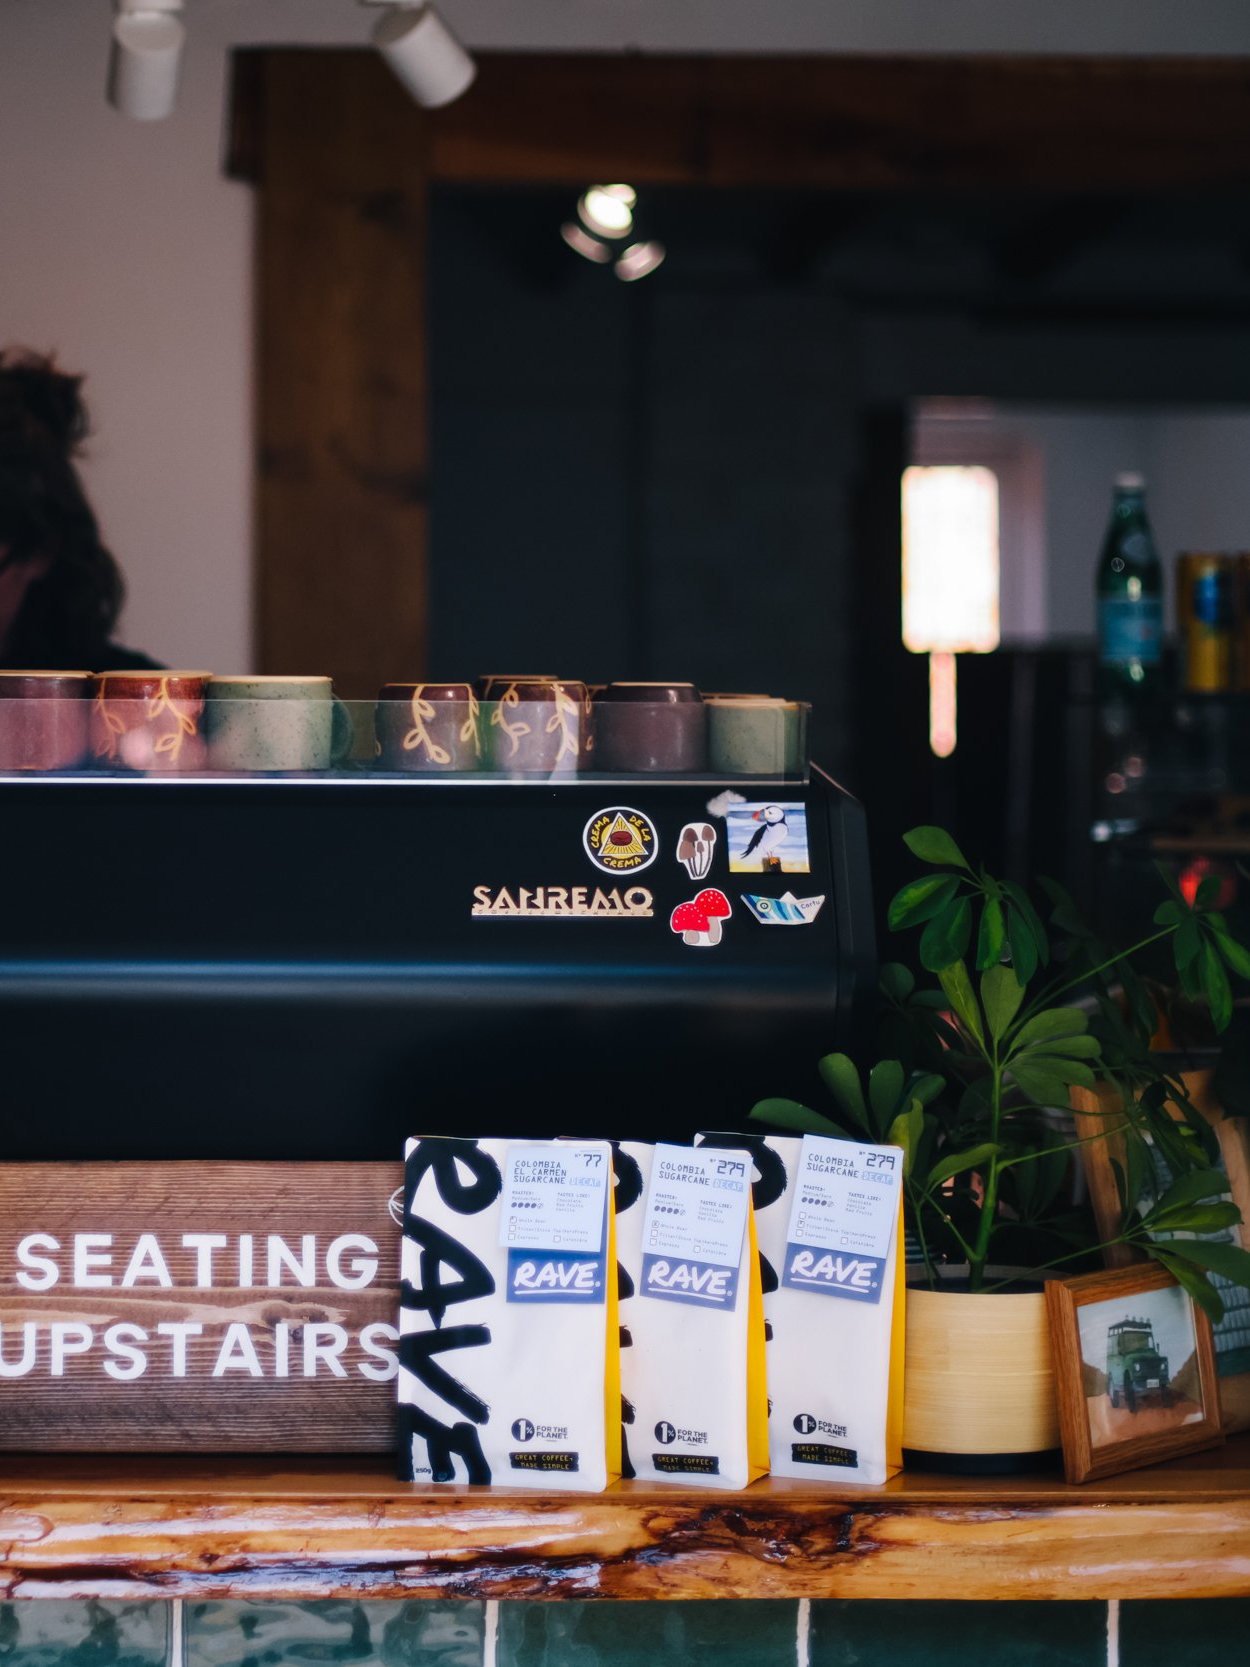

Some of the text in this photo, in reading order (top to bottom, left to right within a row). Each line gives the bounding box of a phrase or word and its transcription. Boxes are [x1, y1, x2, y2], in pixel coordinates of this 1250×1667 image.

[590, 815, 652, 848] CREMA DE LA
[603, 856, 642, 868] CREMA
[472, 885, 653, 910] SANREMO
[515, 1160, 561, 1168] COLOMBIA
[583, 1153, 602, 1168] 77
[660, 1161, 705, 1175] COLOMBIA
[808, 1153, 854, 1168] COLOMBIA
[866, 1152, 895, 1170] 279
[532, 1168, 567, 1177] CARMEN
[717, 1160, 745, 1178] 279
[806, 1163, 894, 1186] SUGARCANE DECAF
[513, 1176, 566, 1184] SUGARCANE
[659, 1171, 710, 1186] SUGARCANE
[15, 1233, 379, 1291] SEATING
[818, 1421, 832, 1429] FOR
[415, 1467, 432, 1475] 250g
[543, 1462, 570, 1470] SIMPLE
